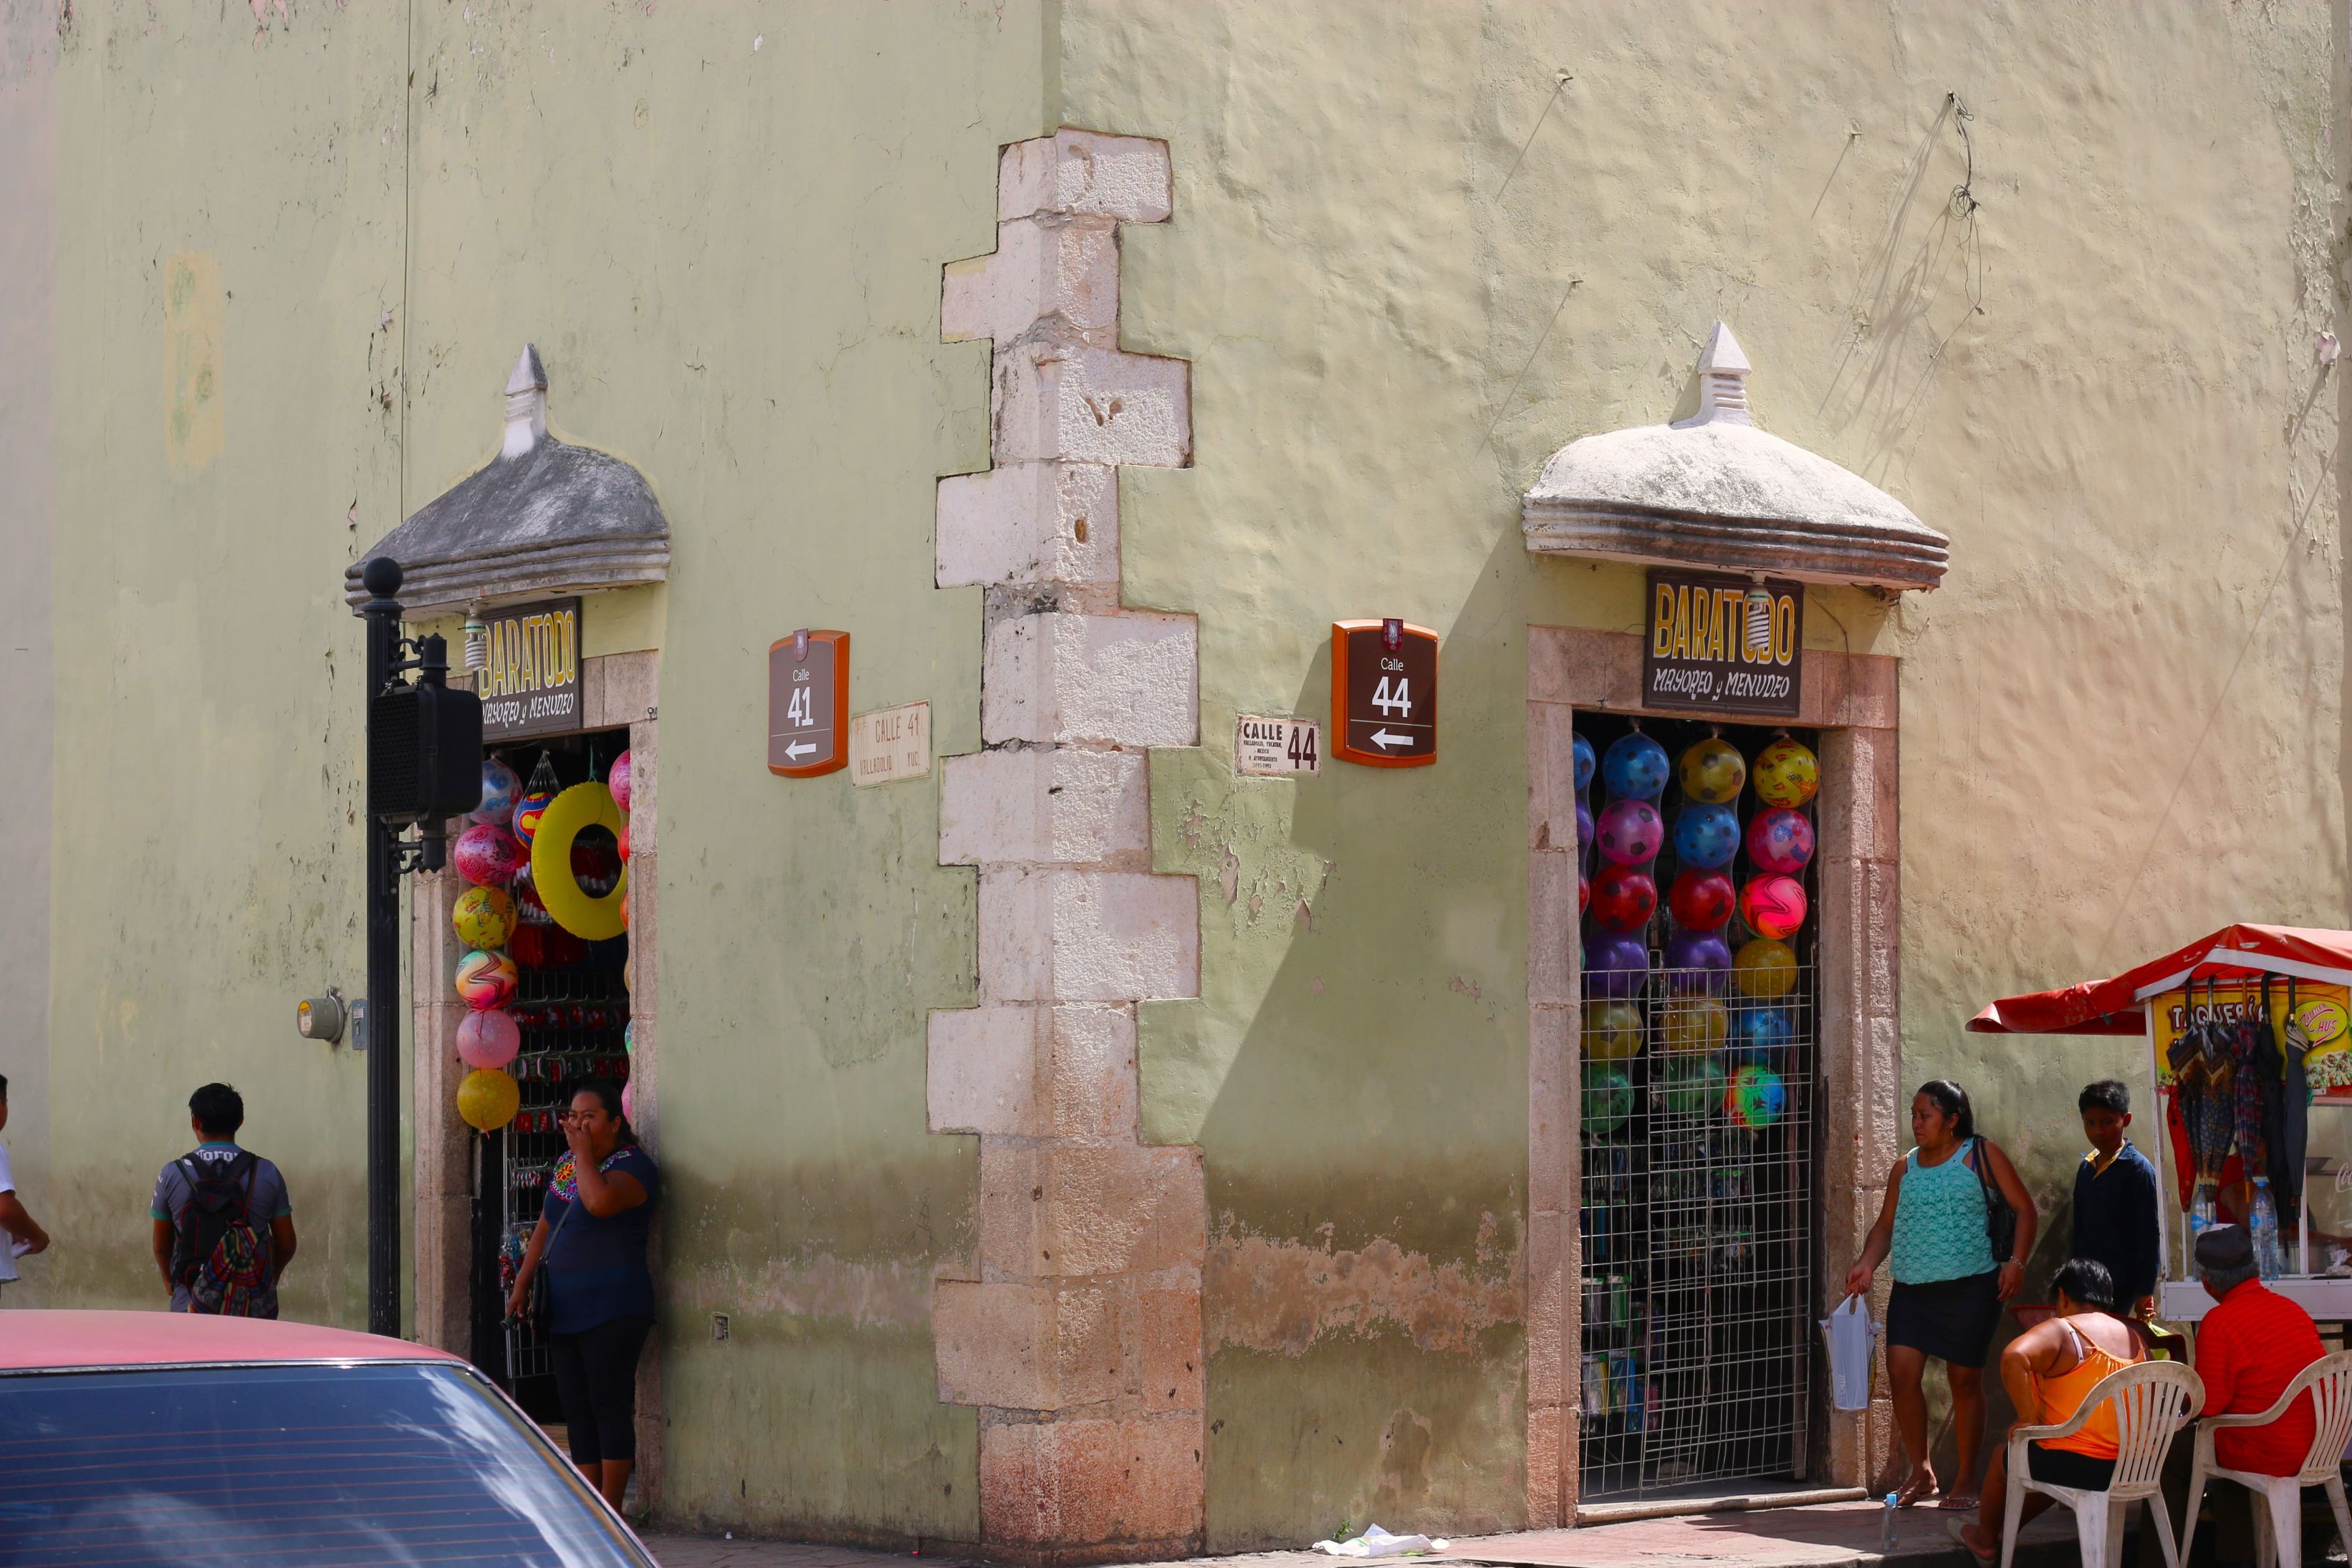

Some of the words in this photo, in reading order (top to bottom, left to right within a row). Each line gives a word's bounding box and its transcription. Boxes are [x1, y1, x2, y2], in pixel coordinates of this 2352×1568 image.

[479, 610, 575, 700] BARATODO
[1381, 657, 1403, 671] Calle
[792, 669, 810, 682] Calle
[1653, 668, 1712, 700] MAYOREO
[1724, 672, 1790, 698] MENUDEO
[529, 693, 574, 719] MENUDEO
[787, 686, 814, 728] 41
[1371, 675, 1412, 718] 44
[875, 716, 901, 743] CALLE
[908, 713, 918, 736] 41
[1243, 722, 1282, 741] CALLE
[1287, 726, 1317, 770] 44
[860, 755, 892, 776] VALLADOLID
